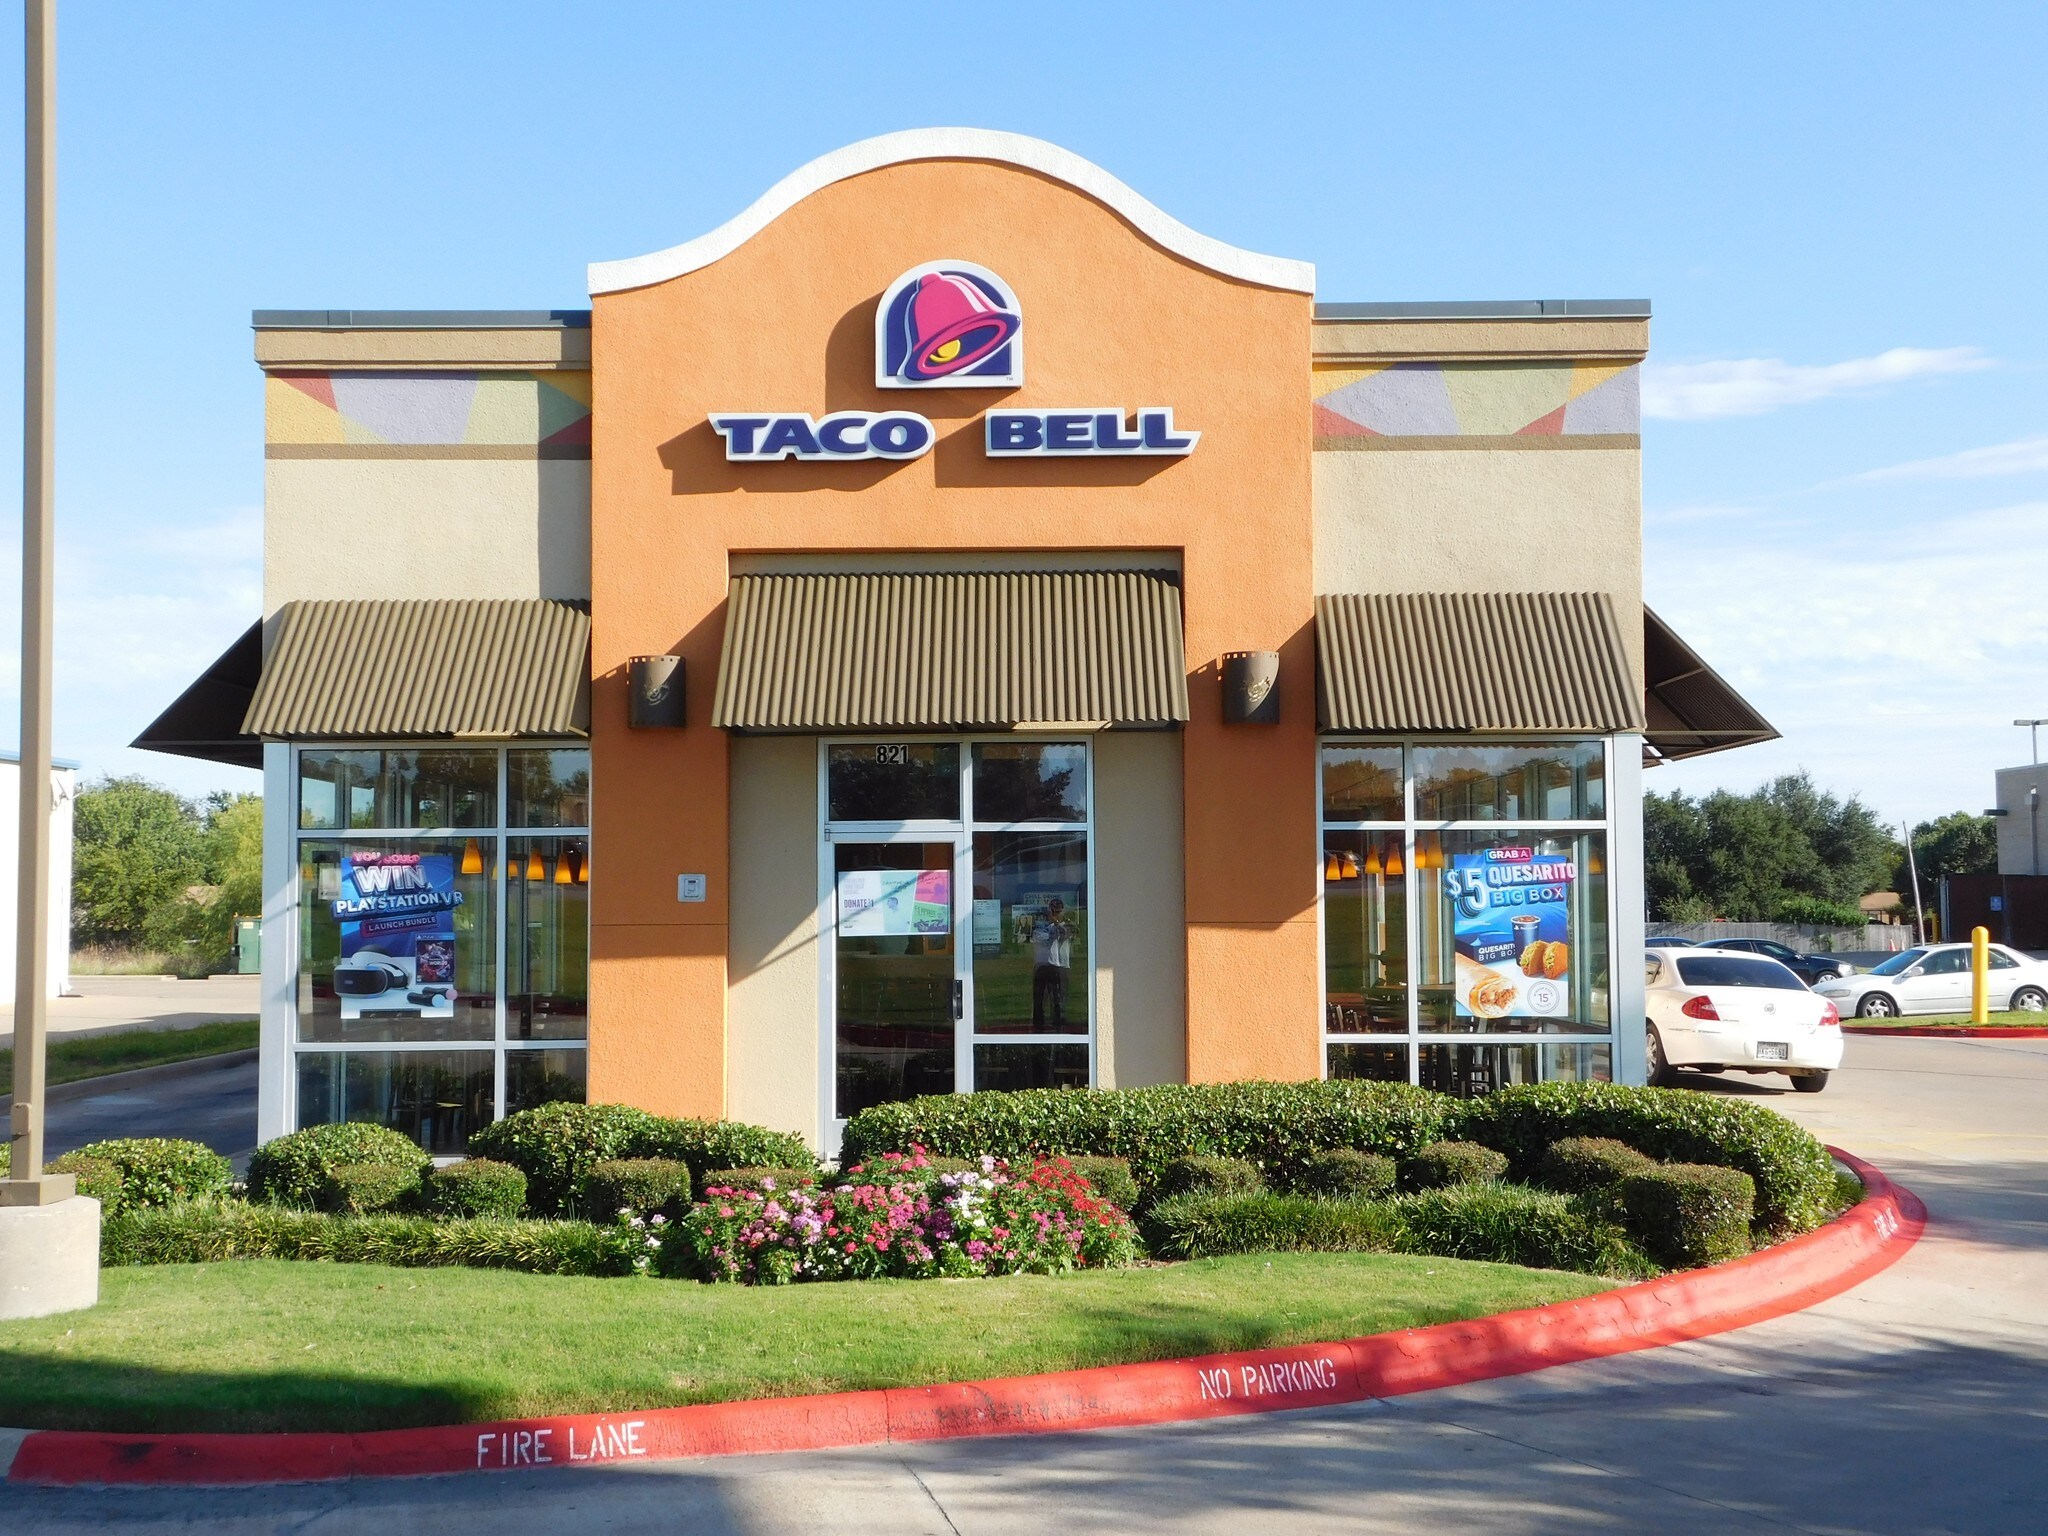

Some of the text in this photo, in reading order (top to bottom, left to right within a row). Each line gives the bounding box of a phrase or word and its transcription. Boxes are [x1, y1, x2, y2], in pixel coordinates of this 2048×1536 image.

[715, 412, 1193, 455] TACO BELL
[876, 745, 908, 764] 821
[352, 851, 381, 862] YOU
[1488, 850, 1528, 859] GRAB A
[353, 865, 426, 892] WIN
[1489, 862, 1577, 884] QUESARITO
[1446, 868, 1488, 909] $5
[1494, 887, 1564, 904] BIG BOX
[336, 891, 463, 913] PLAYSTATION VR
[843, 899, 868, 908] DONATE
[368, 916, 436, 931] LAUNCH BUNDLE
[1478, 952, 1496, 961] BIG
[1538, 993, 1549, 1003] 15
[1199, 1358, 1336, 1399] NO PARKING
[477, 1421, 646, 1467] FIRE LANE
